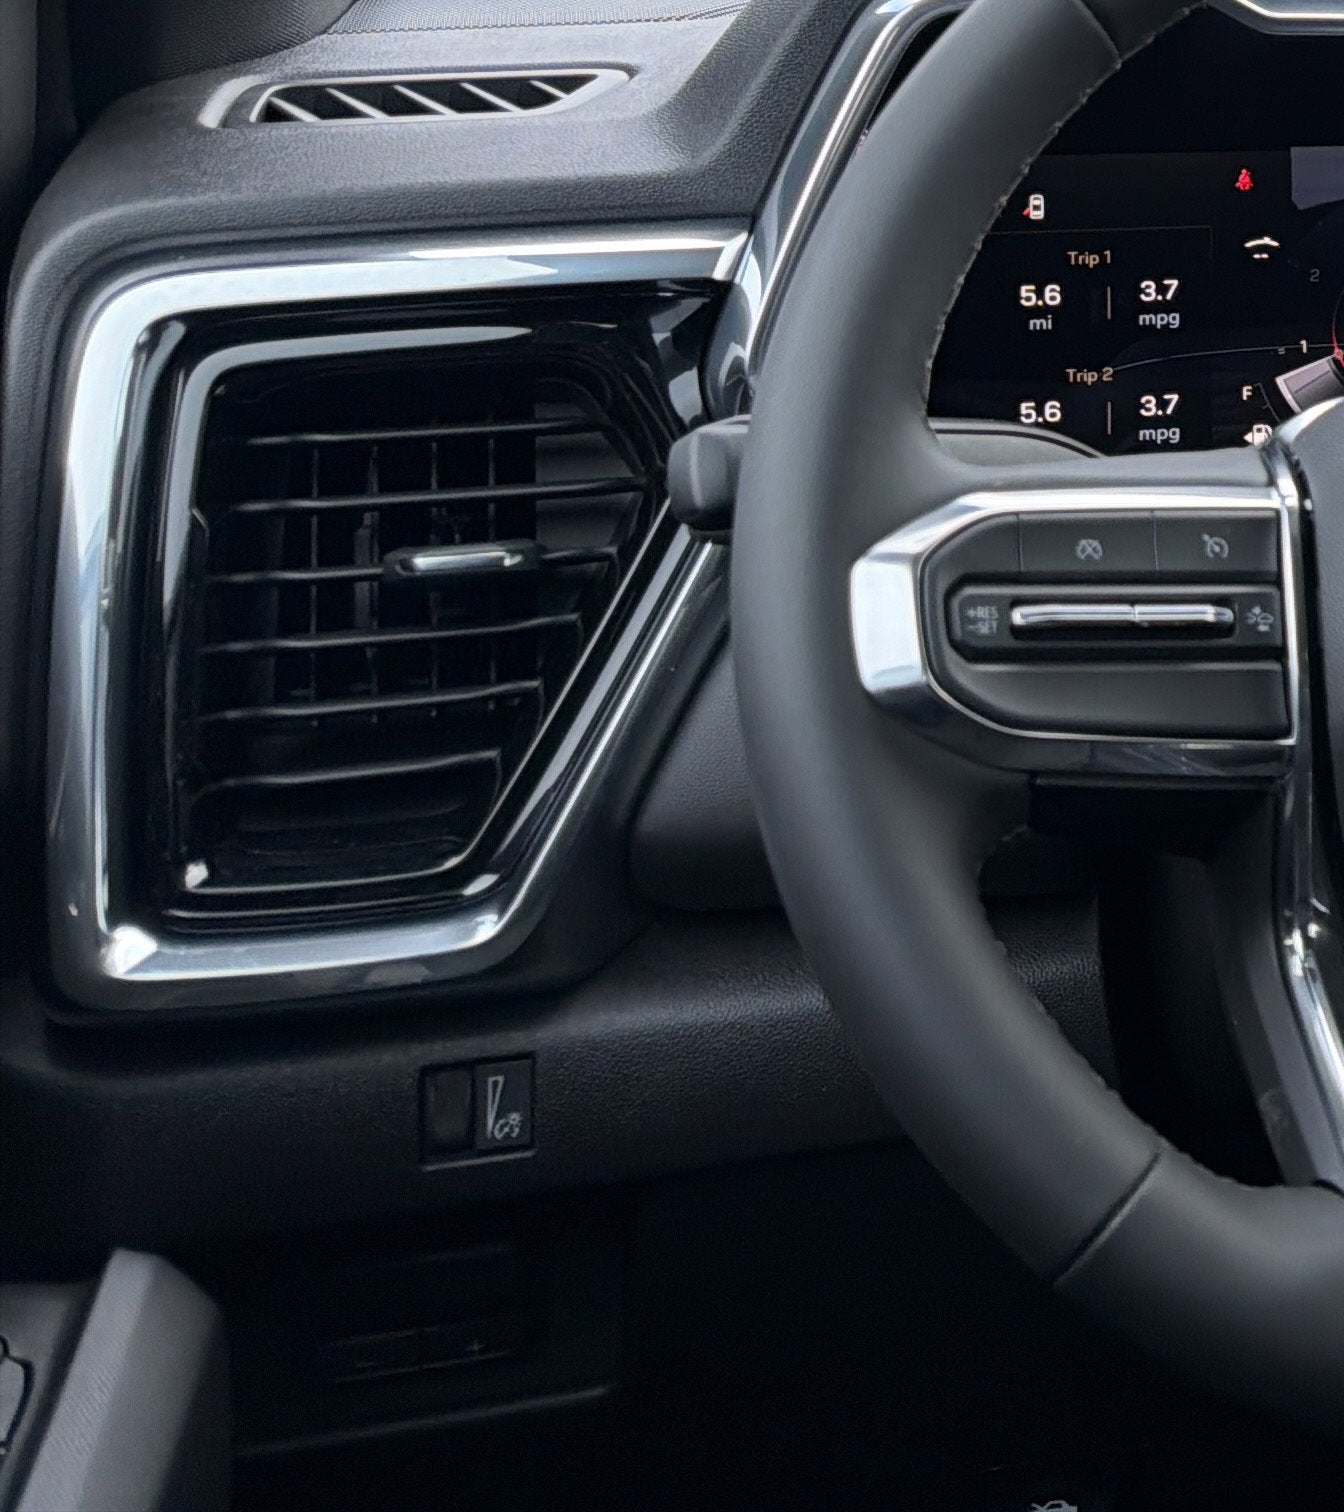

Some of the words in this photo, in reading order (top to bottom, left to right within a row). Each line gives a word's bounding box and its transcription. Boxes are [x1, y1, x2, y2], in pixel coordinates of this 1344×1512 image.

[1066, 251, 1100, 268] Trip
[1104, 250, 1111, 264] 1
[1310, 268, 1320, 282] 2
[1019, 284, 1062, 308] 5.6
[1139, 279, 1180, 302] 3.7
[1028, 315, 1053, 331] mi
[1138, 312, 1180, 330] mpg
[1300, 339, 1309, 354] 1
[1065, 368, 1100, 387] Trip
[1102, 366, 1114, 383] 2
[1242, 386, 1252, 401] F
[1019, 400, 1062, 424] 5.6
[1139, 394, 1180, 417] 3.7
[1138, 426, 1180, 444] mpg
